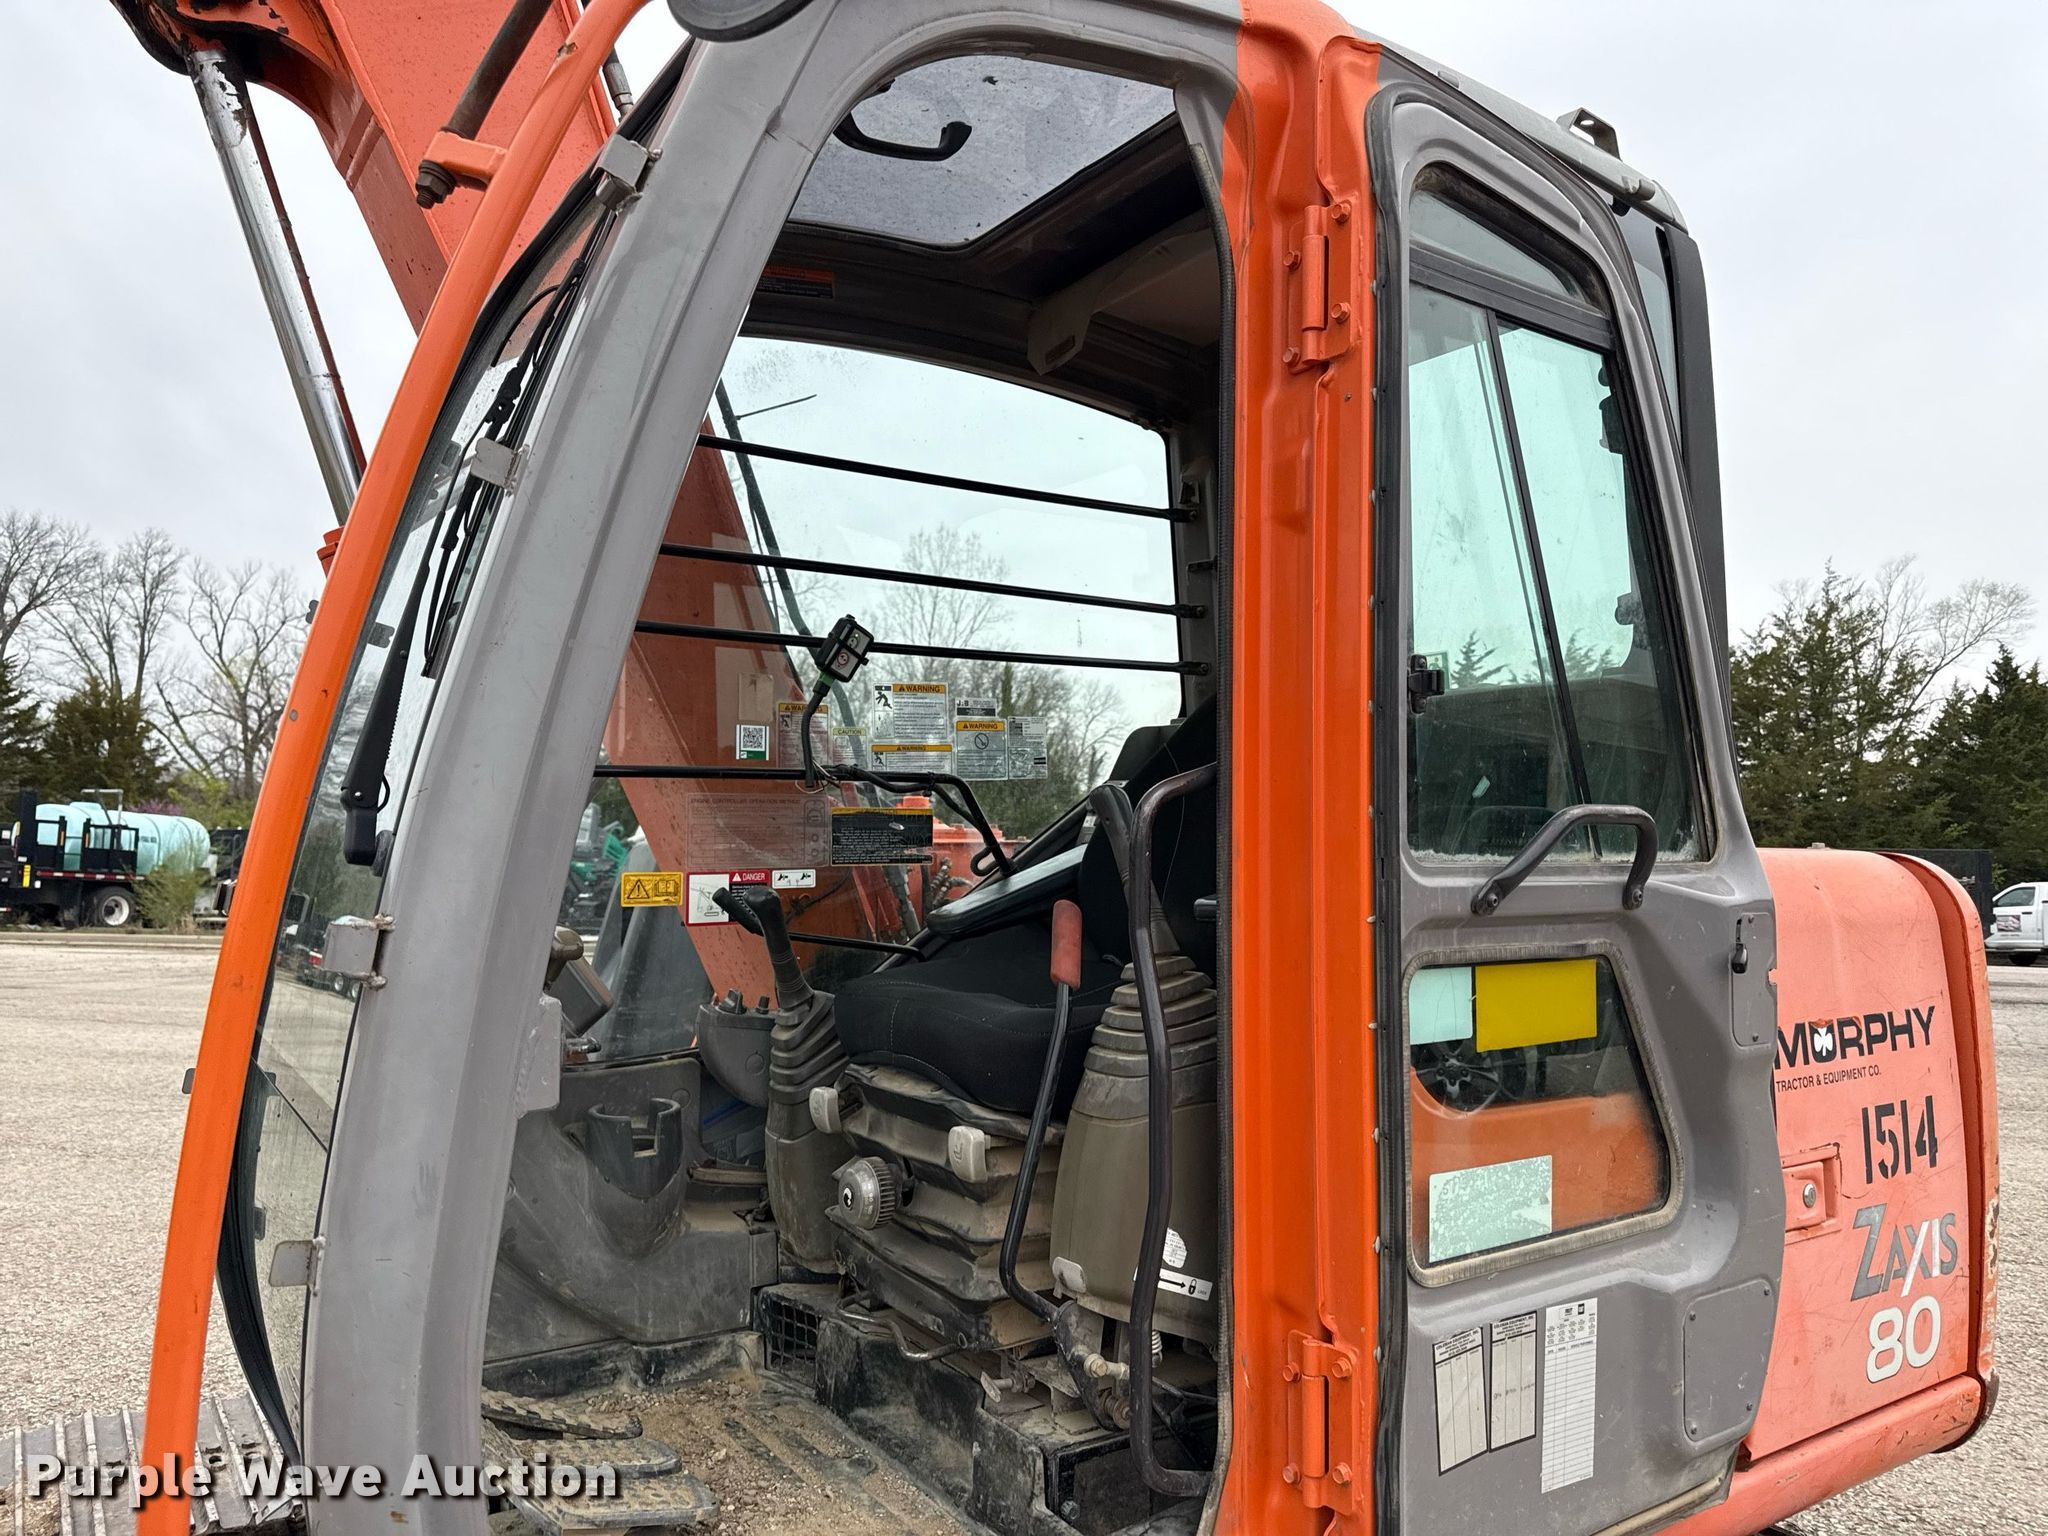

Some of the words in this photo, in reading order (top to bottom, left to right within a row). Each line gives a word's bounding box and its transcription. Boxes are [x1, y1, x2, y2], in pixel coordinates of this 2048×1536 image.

[906, 685, 941, 693] WARNING
[742, 873, 766, 881] DANGER
[1774, 1006, 1936, 1070] MURPHY
[1776, 1075, 1815, 1093] TRACTOR
[1816, 1074, 1822, 1086] &
[1823, 1067, 1867, 1085] EQUIPMENT
[1868, 1064, 1882, 1076] CO.
[1861, 1095, 1938, 1185] 1514
[1866, 1295, 1941, 1384] 80
